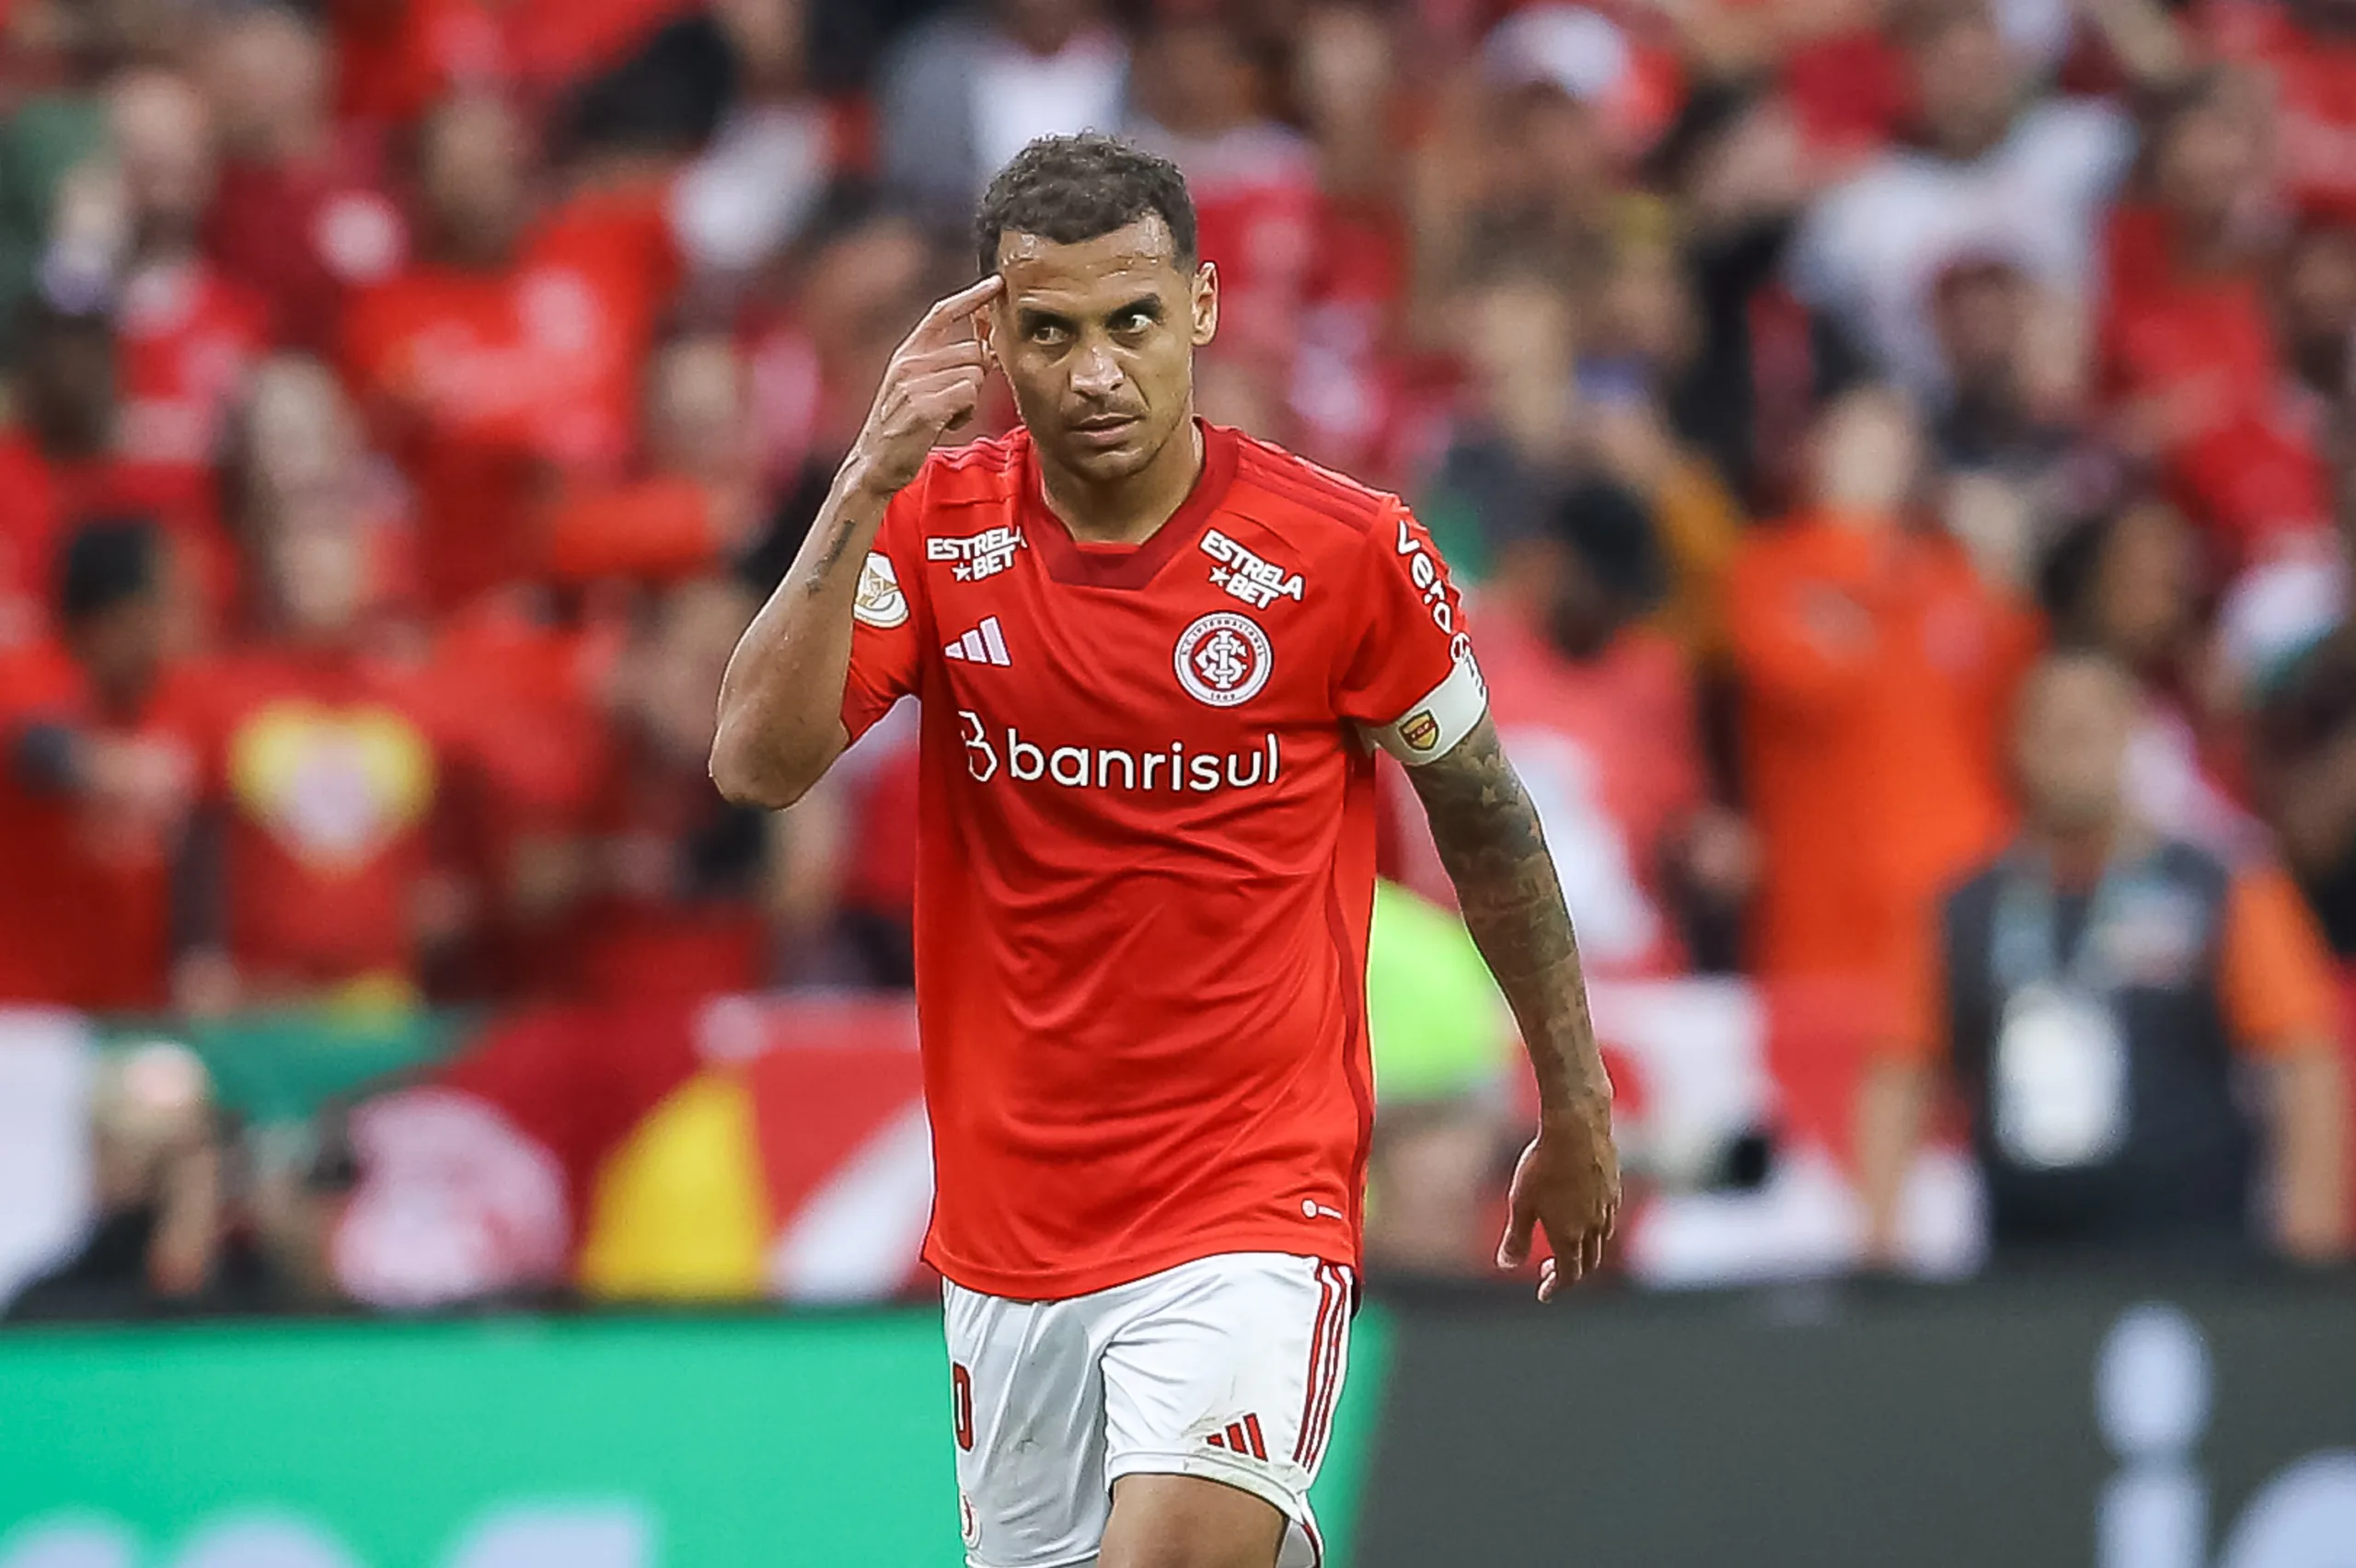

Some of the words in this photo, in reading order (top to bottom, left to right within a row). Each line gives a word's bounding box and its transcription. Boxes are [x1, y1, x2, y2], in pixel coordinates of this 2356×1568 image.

[972, 544, 1016, 581] BET
[1199, 528, 1304, 601] ESTRELA
[1225, 572, 1280, 609] BET
[1007, 727, 1276, 792] banrisul
